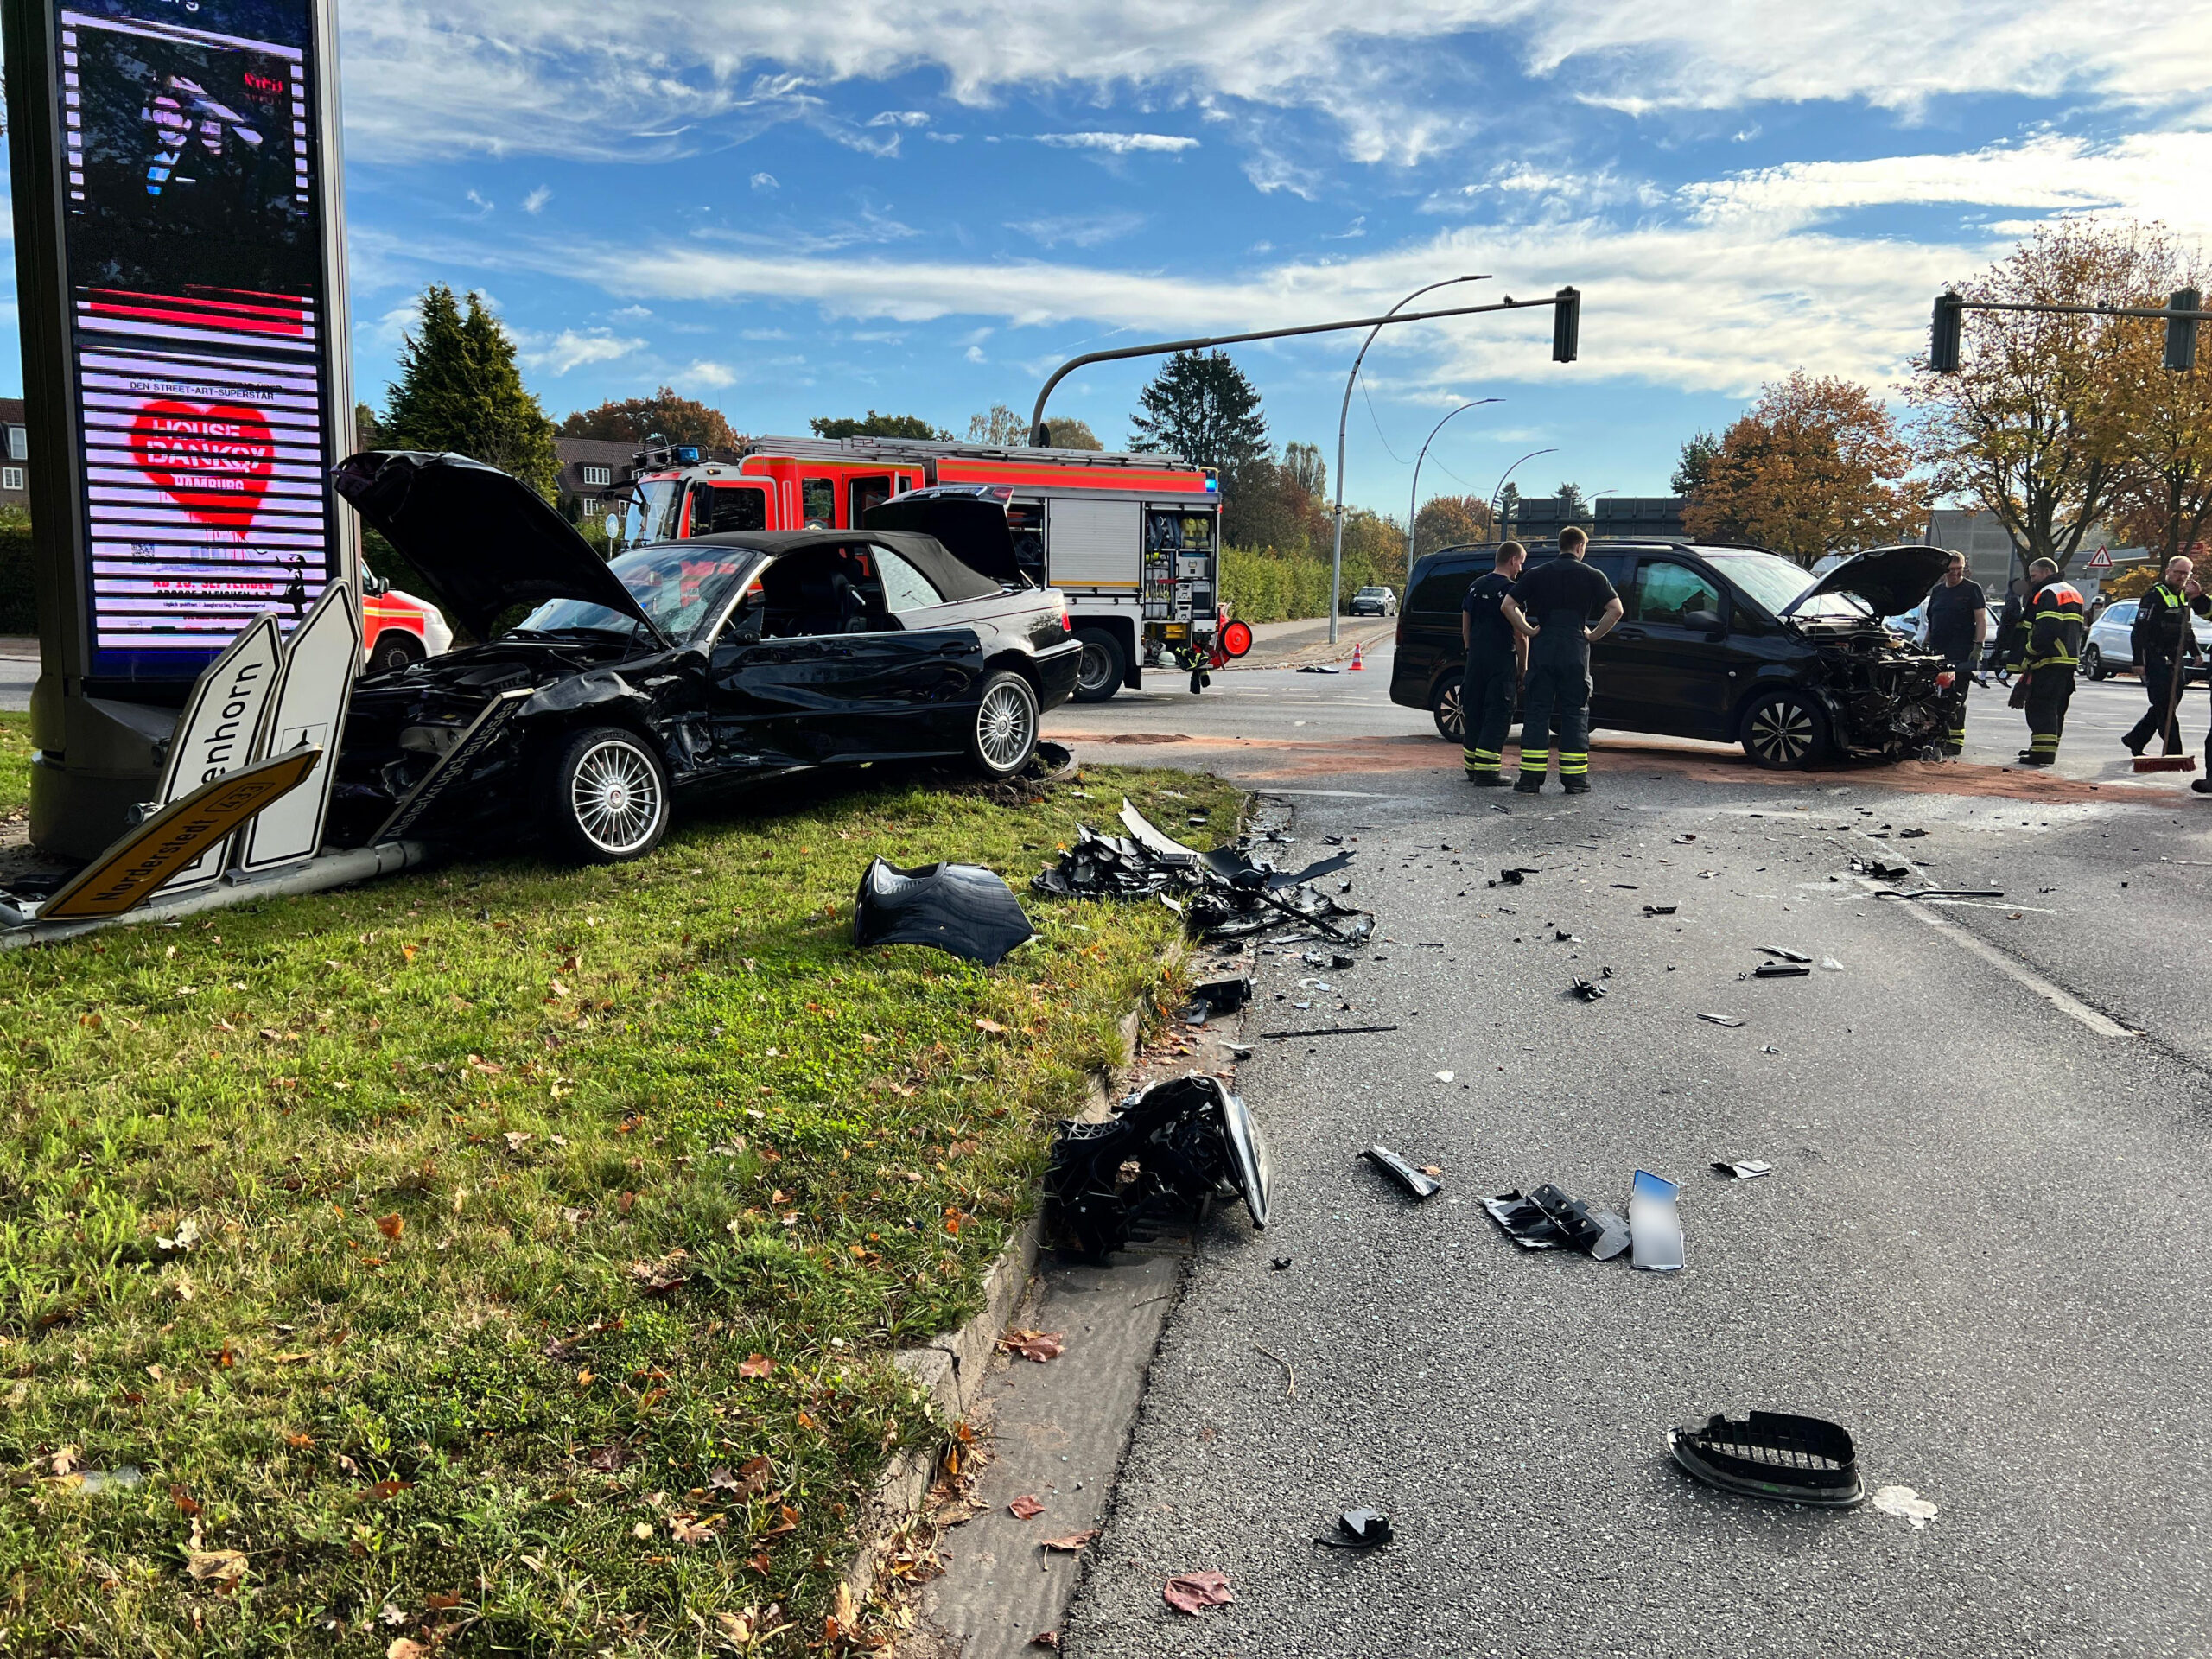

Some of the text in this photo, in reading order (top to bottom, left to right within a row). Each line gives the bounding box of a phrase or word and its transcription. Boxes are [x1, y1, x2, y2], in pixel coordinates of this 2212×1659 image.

[130, 381, 149, 391] DEN
[153, 383, 274, 400] STREET-ART-SUPERSTAR
[153, 419, 240, 439] HOUSE
[385, 701, 519, 837] Alsterkrugchaussee
[219, 785, 264, 809] 433
[90, 818, 220, 902] Norderstedt
